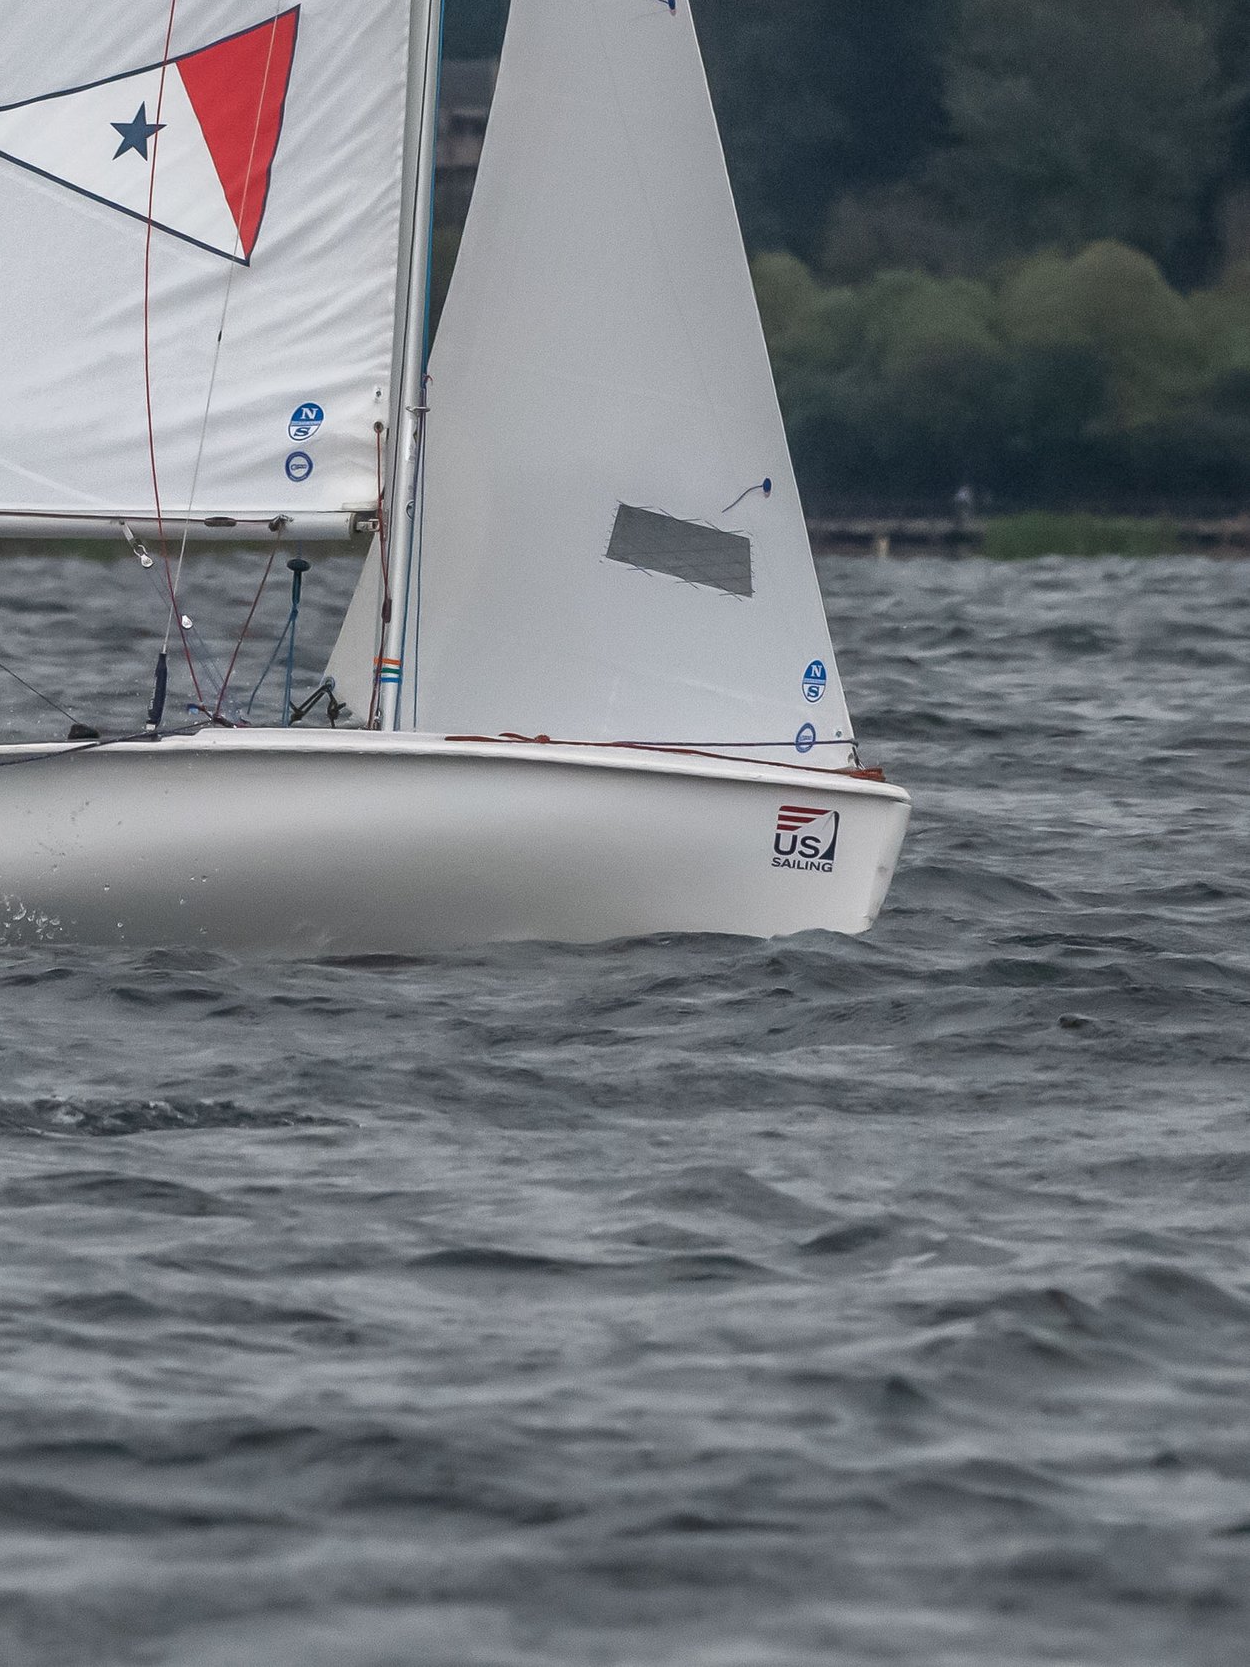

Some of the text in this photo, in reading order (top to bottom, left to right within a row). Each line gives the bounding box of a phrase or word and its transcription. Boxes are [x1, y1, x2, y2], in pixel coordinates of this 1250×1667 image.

[300, 407, 319, 420] N
[293, 426, 312, 437] S
[811, 665, 822, 678] N
[807, 685, 819, 698] S
[773, 832, 822, 859] US
[771, 856, 833, 873] SAILING
